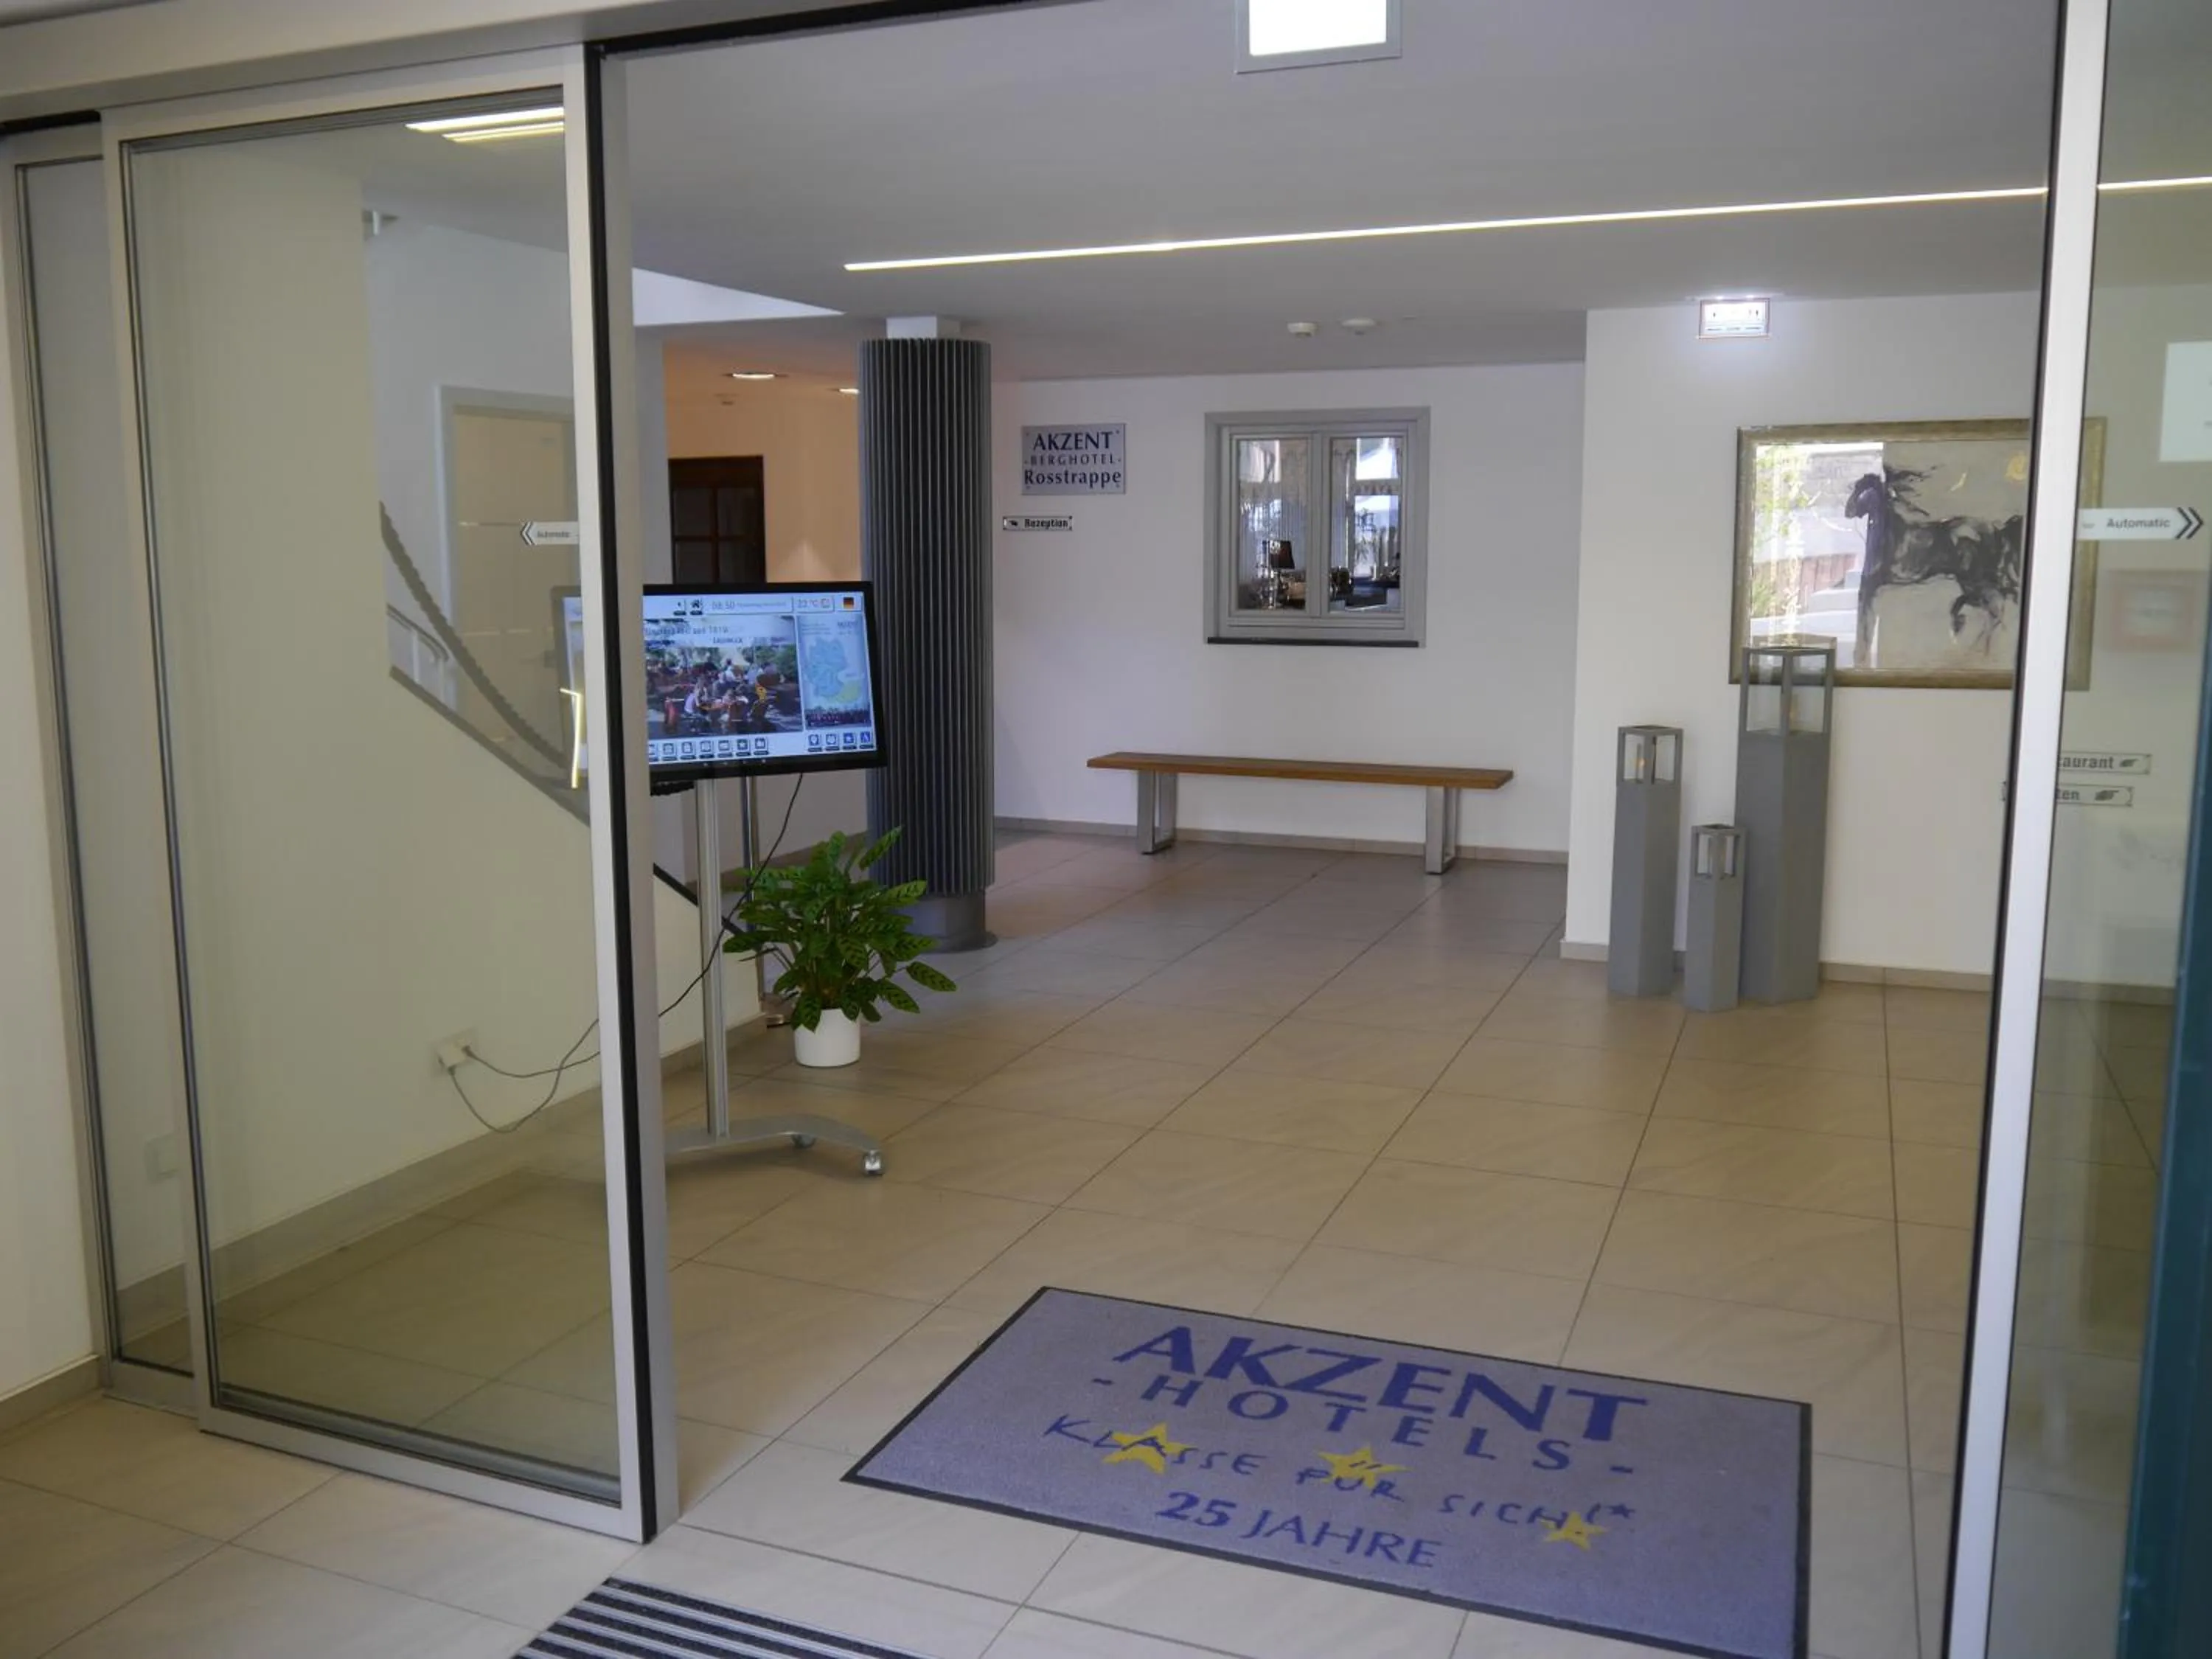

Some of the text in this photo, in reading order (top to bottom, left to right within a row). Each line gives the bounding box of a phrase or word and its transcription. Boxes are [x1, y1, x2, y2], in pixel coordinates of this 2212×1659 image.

[1033, 431, 1113, 451] AKZENT
[1024, 470, 1121, 490] Rosstrappe
[1024, 518, 1068, 529] Rezeption
[2107, 518, 2171, 529] Automatic
[1112, 1326, 1649, 1441] AKZENT
[1043, 1413, 1268, 1475] KLASSE
[1295, 1460, 1405, 1503] FÜR
[1154, 1491, 1443, 1568] 25 JAHRE
